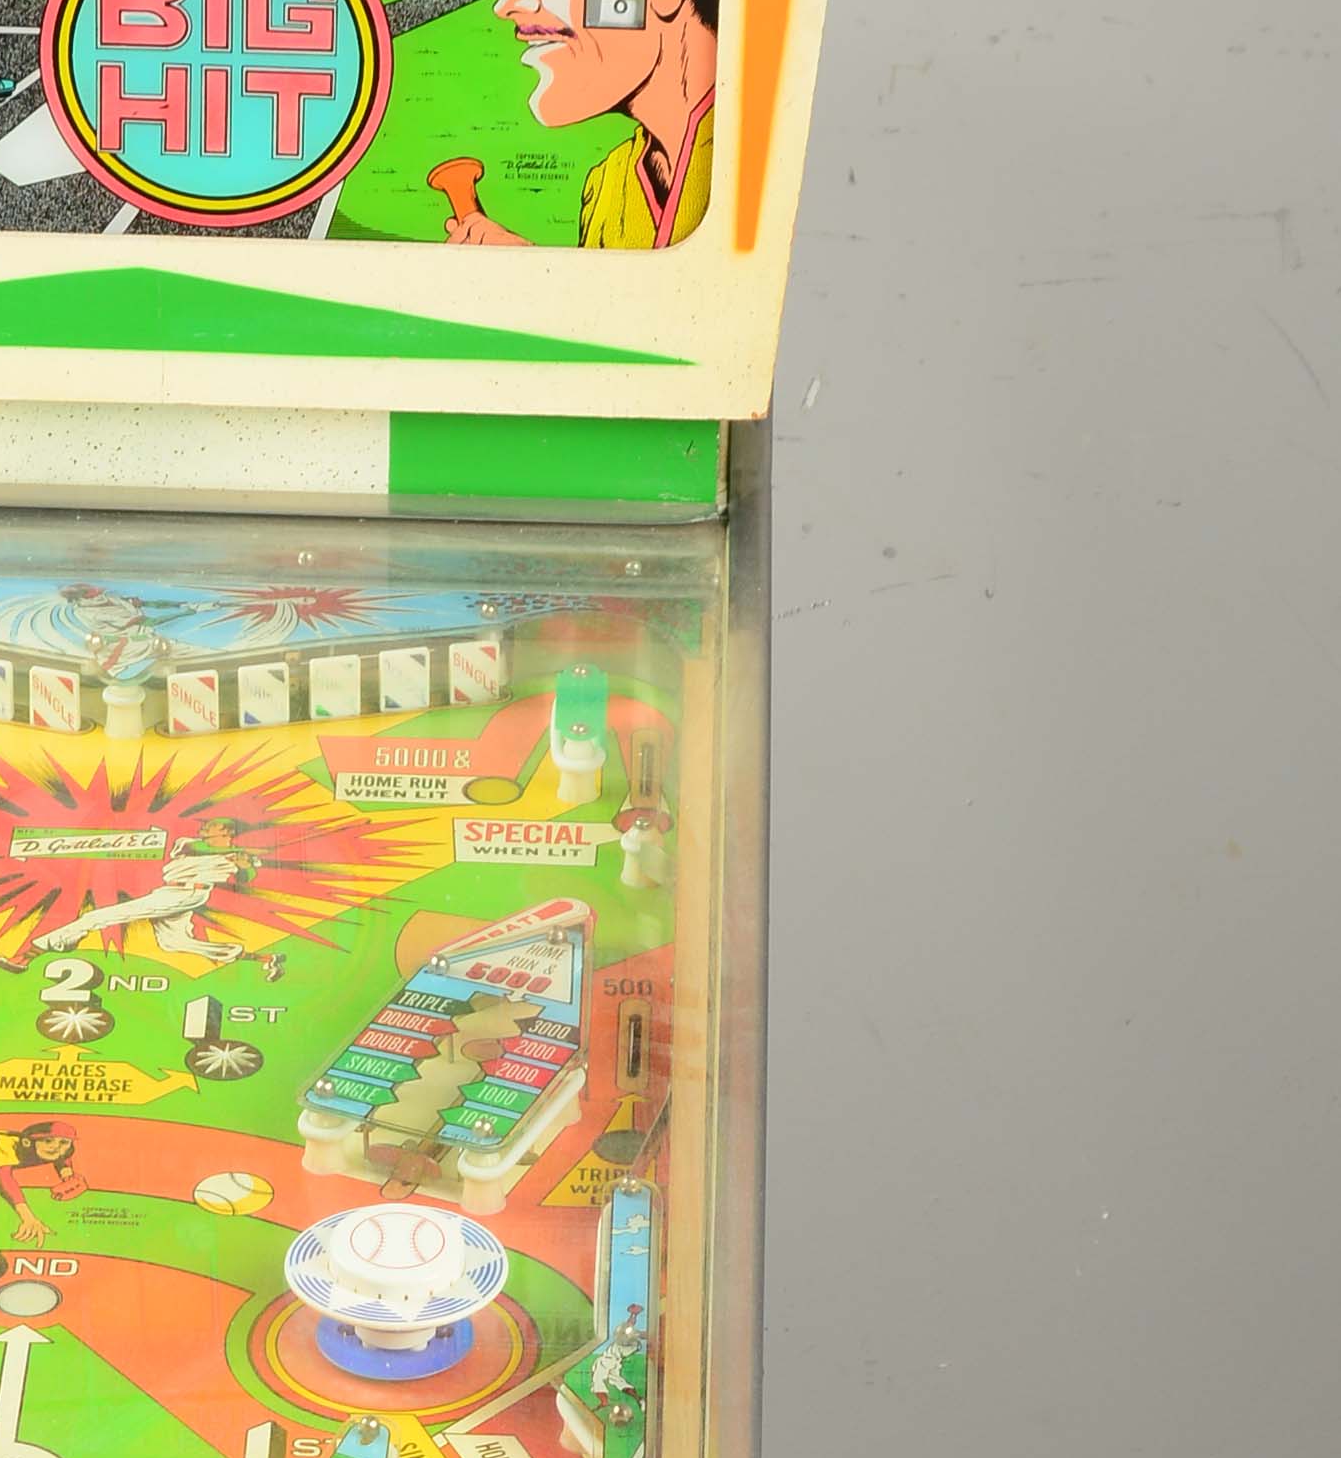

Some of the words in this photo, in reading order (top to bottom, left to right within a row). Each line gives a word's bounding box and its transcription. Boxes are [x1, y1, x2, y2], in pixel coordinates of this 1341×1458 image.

[95, 60, 337, 161] HIT
[171, 682, 217, 729] SINGLE
[453, 651, 497, 694] SINGLE
[32, 674, 75, 729] SINGLE
[375, 746, 448, 769] 5000
[453, 749, 471, 769] &
[351, 775, 403, 788] HOME
[409, 776, 448, 789] RUN
[344, 788, 407, 799] WHEN
[414, 790, 448, 800] LIT
[464, 822, 591, 846] SPECIAL
[48, 836, 123, 853] Gottlieb
[472, 846, 539, 856] WHEN
[548, 848, 582, 858] LIT
[526, 944, 568, 960] HOME
[506, 955, 539, 970] RUN
[39, 957, 170, 1003] 2ND
[466, 962, 553, 994] 5000
[603, 978, 653, 996] 500
[397, 992, 452, 1012] TRIPLE
[182, 995, 287, 1039] 1ST
[377, 1009, 437, 1033] DOUBLE
[527, 1020, 571, 1040] 3000
[358, 1031, 419, 1055] DOUBLE
[514, 1039, 557, 1060] 2000
[31, 1063, 106, 1077] PLACES
[344, 1055, 403, 1079] SINGLE
[495, 1062, 540, 1082] 2000
[0, 1076, 45, 1089] MAN
[51, 1077, 78, 1091] ON
[83, 1079, 133, 1093] BASE
[13, 1092, 78, 1101] WHEN
[84, 1092, 118, 1102] LIT
[477, 1084, 519, 1106] 1000
